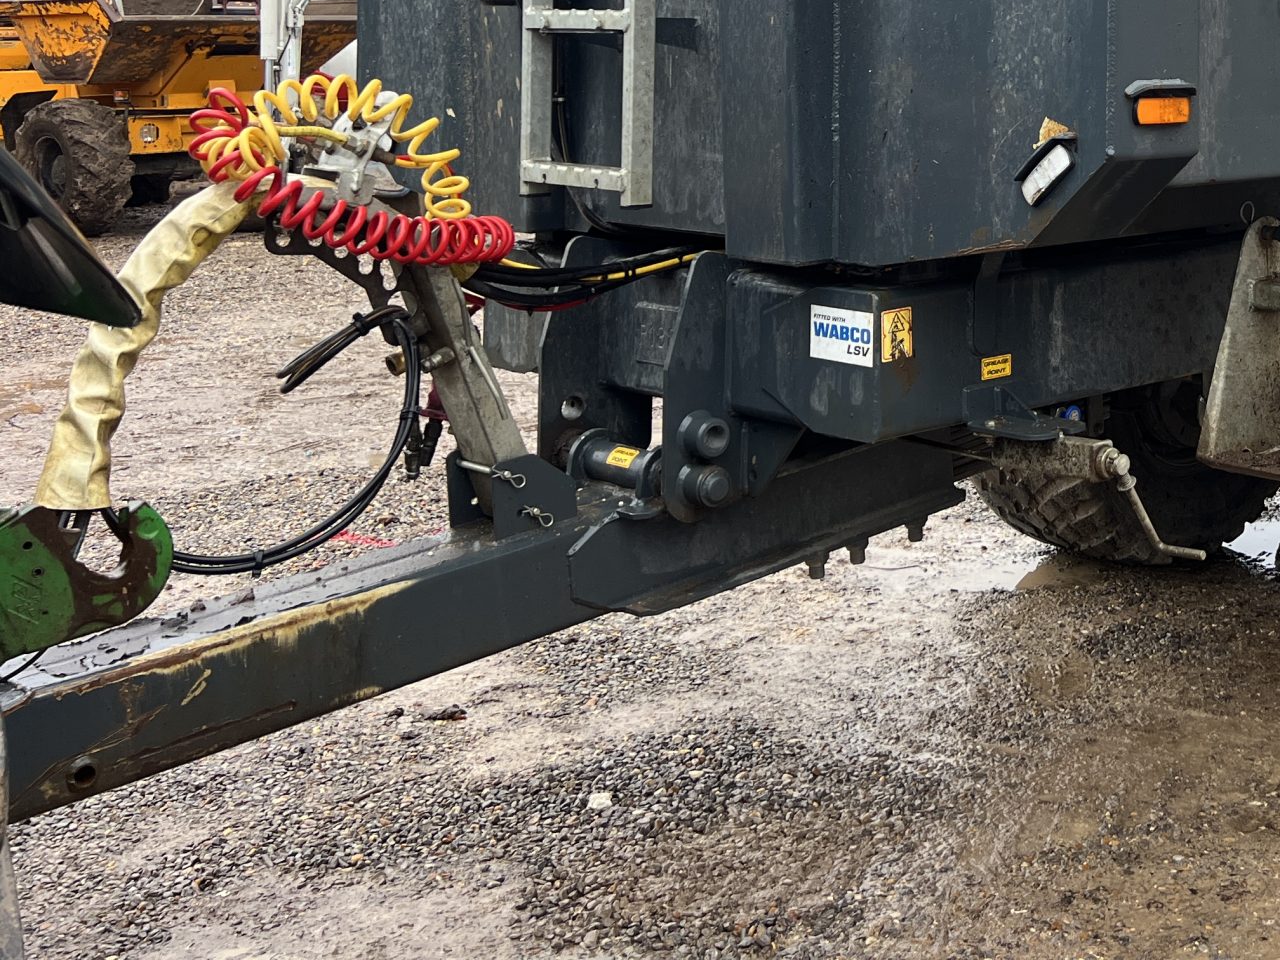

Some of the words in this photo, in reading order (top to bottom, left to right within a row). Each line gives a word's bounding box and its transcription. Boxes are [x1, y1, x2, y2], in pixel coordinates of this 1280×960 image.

[813, 313, 831, 321] FITTED
[832, 315, 846, 323] WITH
[813, 321, 871, 345] WABCO
[846, 344, 870, 357] LSV
[984, 358, 1009, 368] GREASE
[986, 367, 1006, 376] POINT
